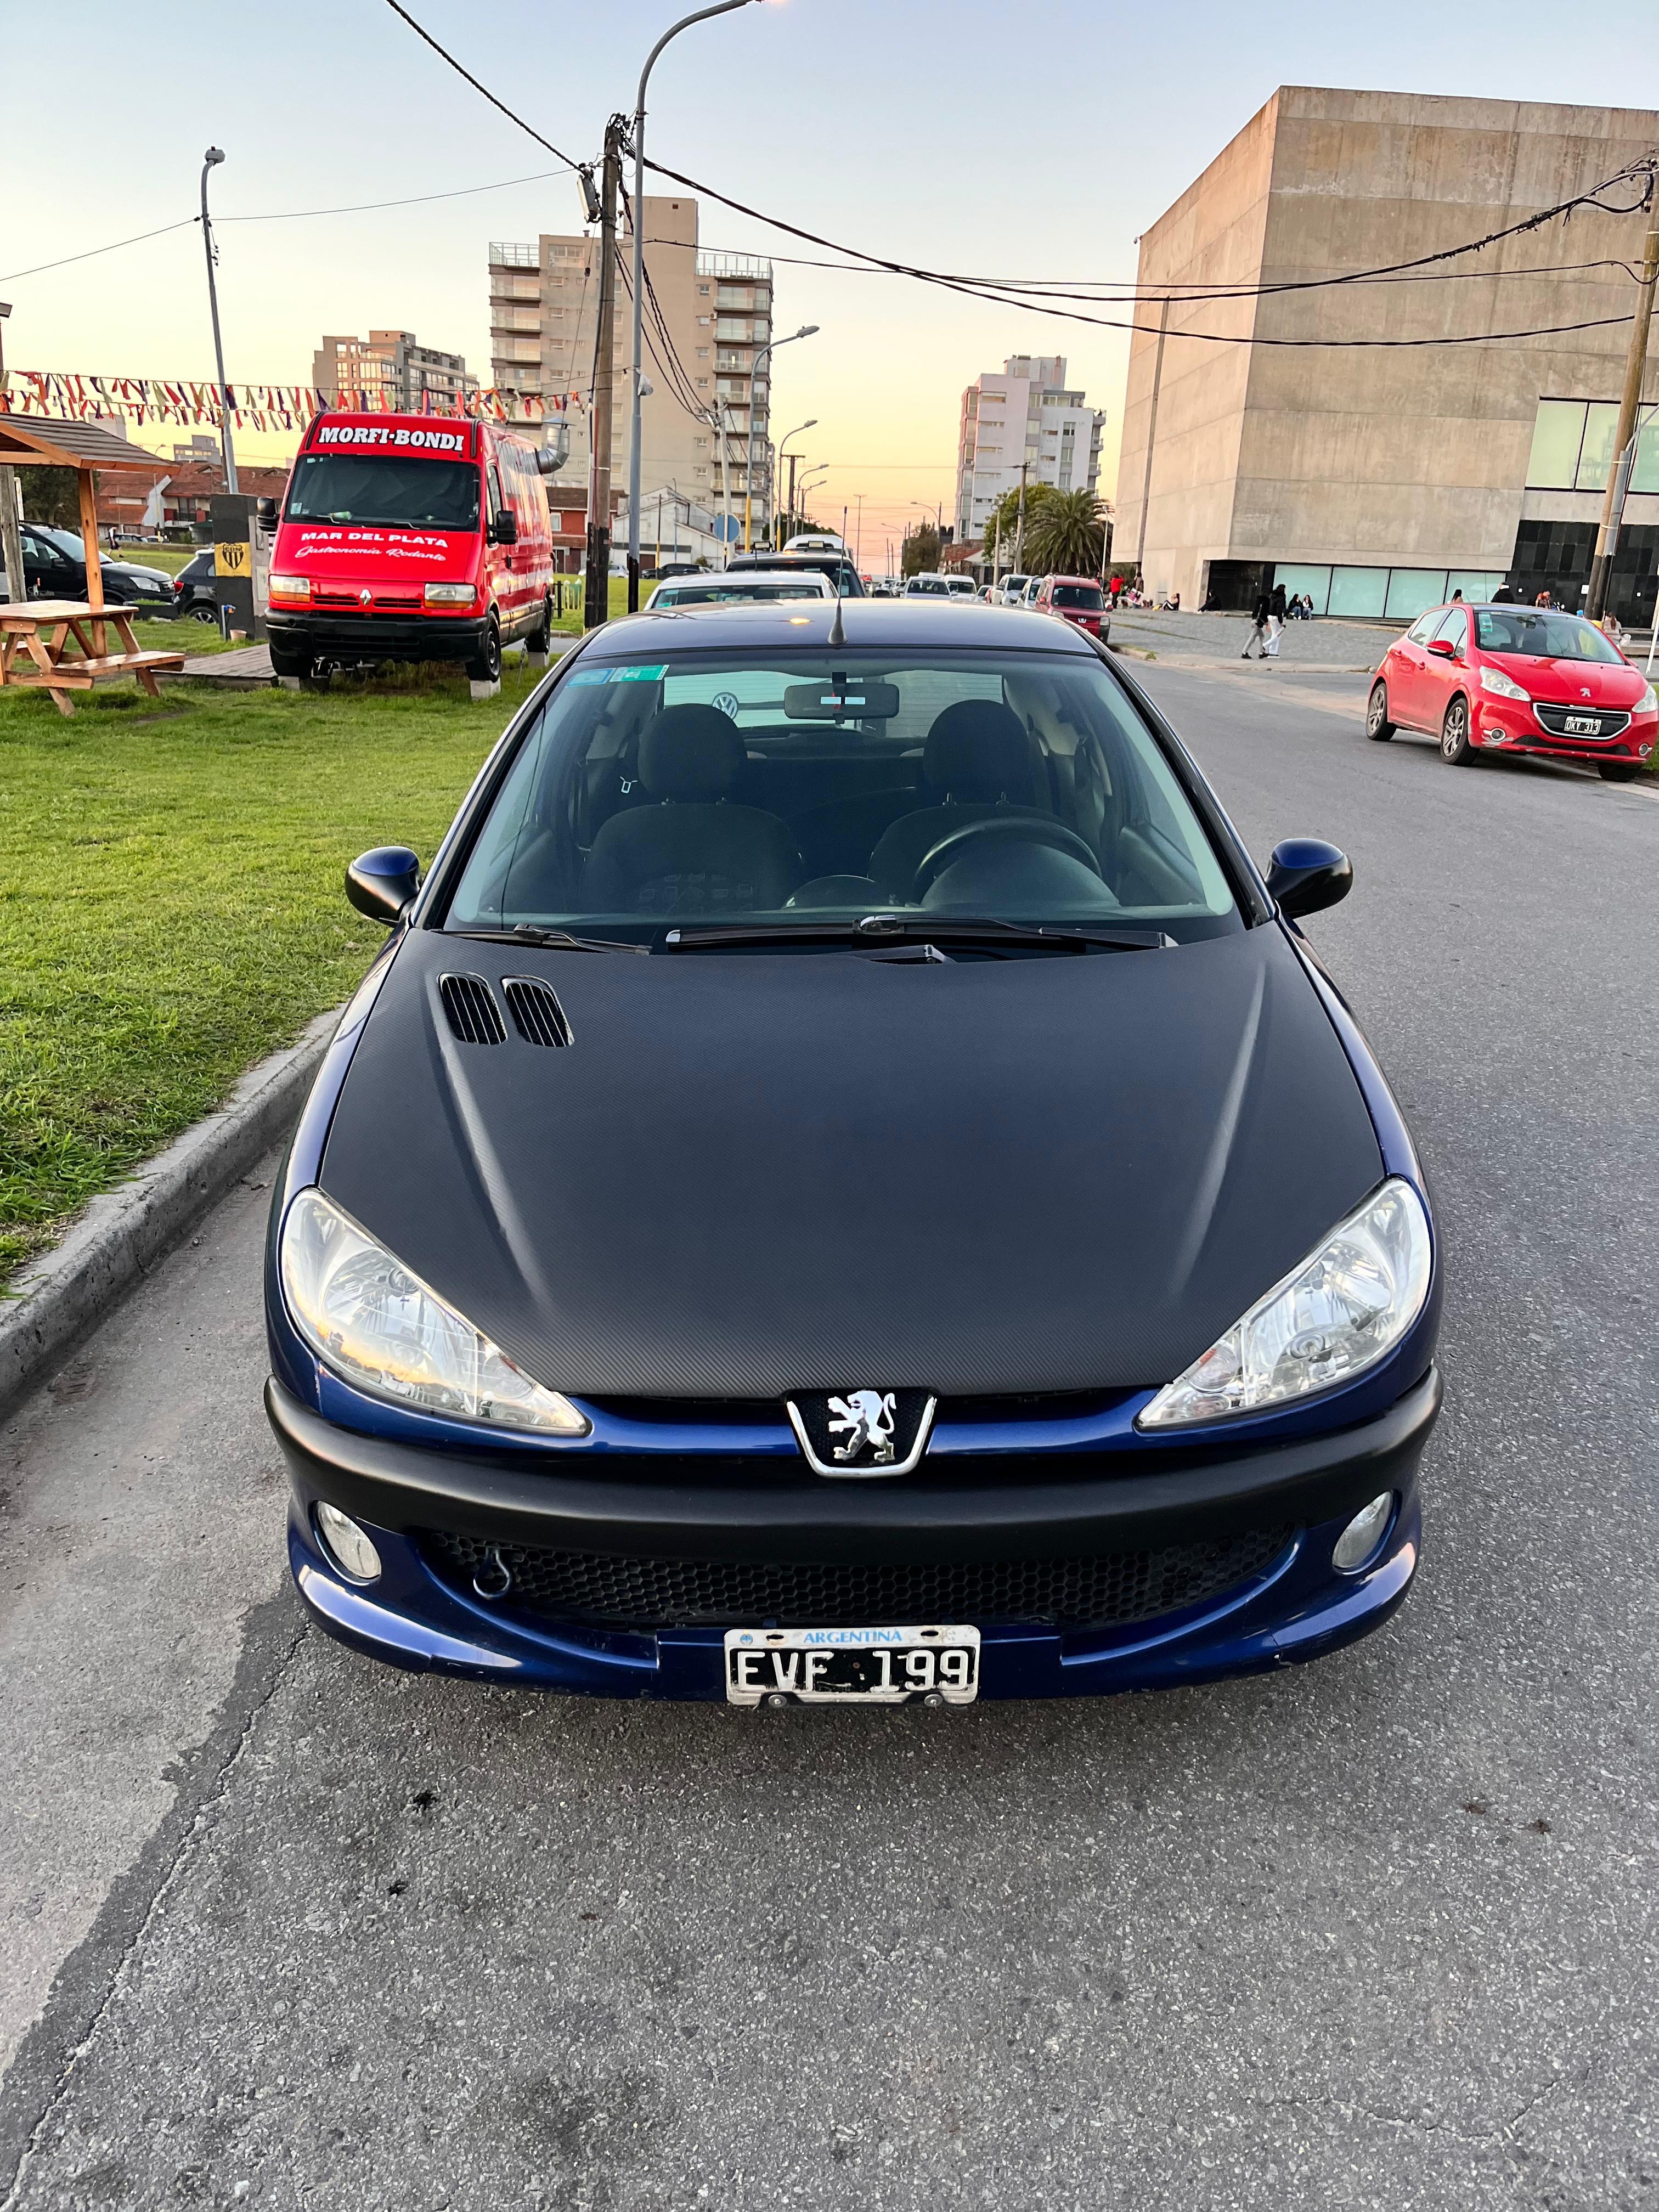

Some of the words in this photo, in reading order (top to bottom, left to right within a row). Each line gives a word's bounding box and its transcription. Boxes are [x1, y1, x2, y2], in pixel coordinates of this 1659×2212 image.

[319, 427, 464, 451] MORFI-BONDI
[301, 532, 342, 541] MAR
[348, 532, 385, 541] DEL
[388, 534, 448, 548] PLATA
[386, 548, 447, 561] Rodante
[1566, 721, 1581, 731] OKY
[1584, 723, 1599, 732] 313
[804, 1630, 902, 1644] ARGENTINA
[737, 1651, 834, 1691] EVF
[870, 1650, 969, 1692] 199
